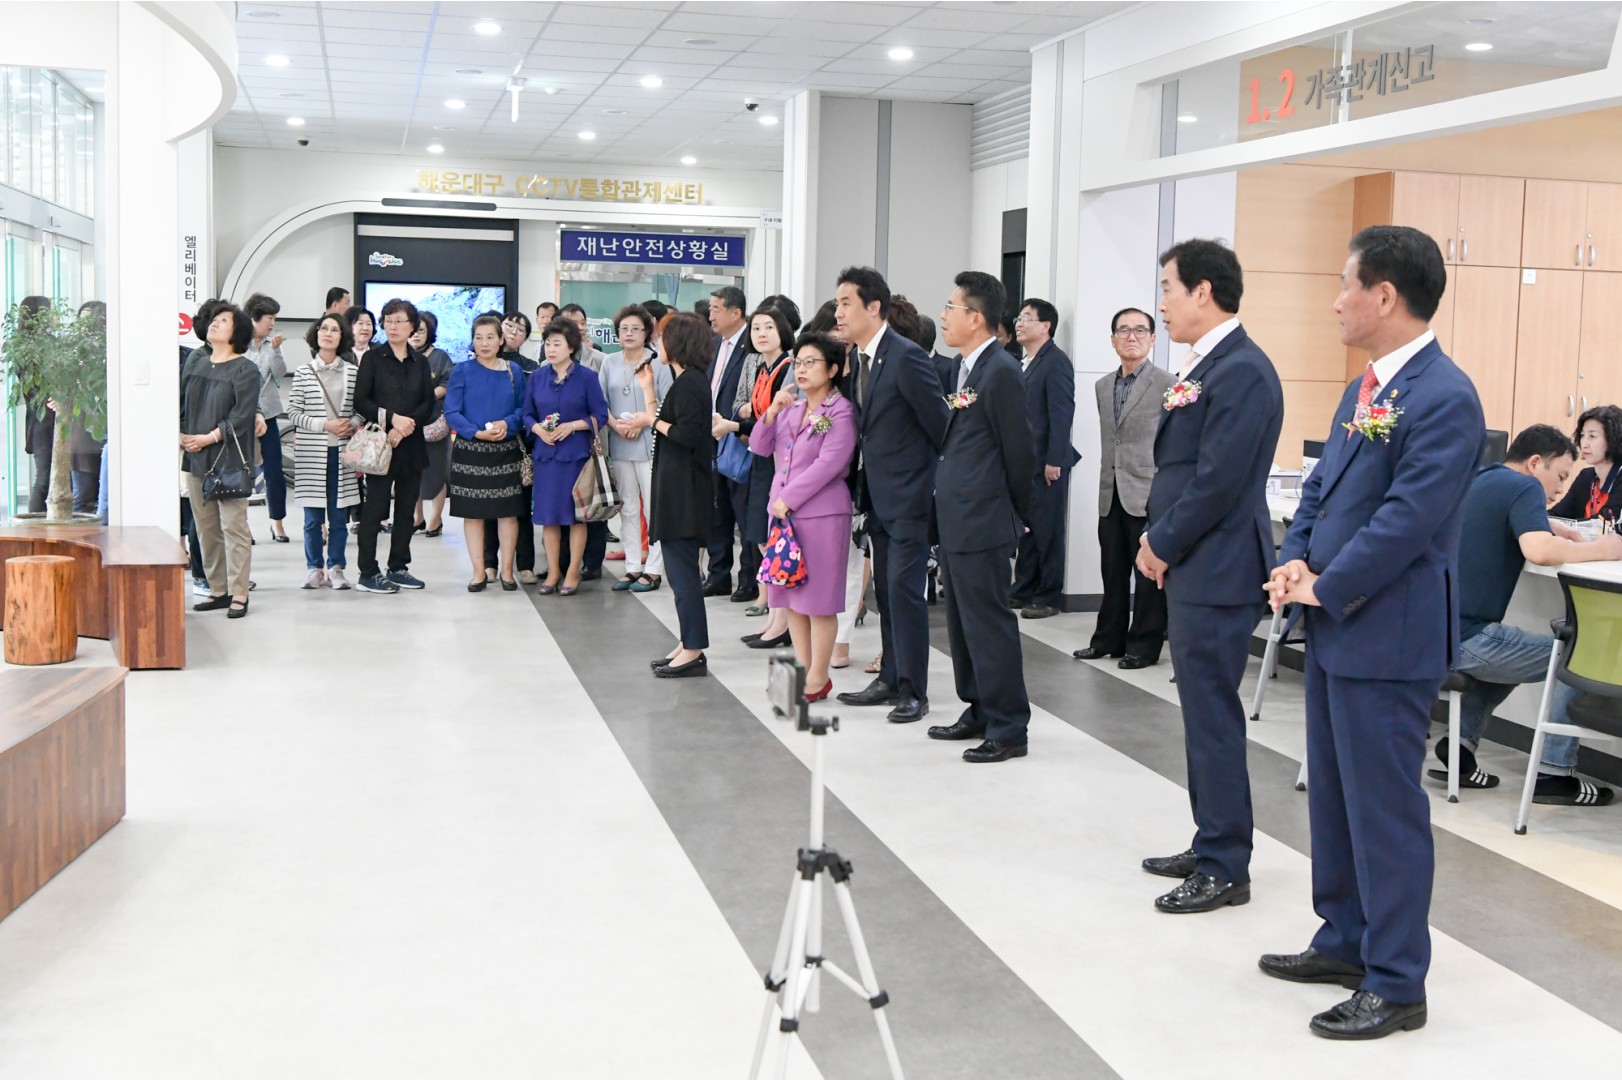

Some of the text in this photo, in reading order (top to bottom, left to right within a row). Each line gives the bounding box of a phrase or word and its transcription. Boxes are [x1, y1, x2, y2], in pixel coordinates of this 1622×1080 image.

[1304, 44, 1435, 110] 가족관계신고
[418, 170, 703, 205] 해운대구 CCTV통합관제센터
[184, 235, 197, 303] 엘리베이터
[577, 237, 729, 261] 재난안전상황실
